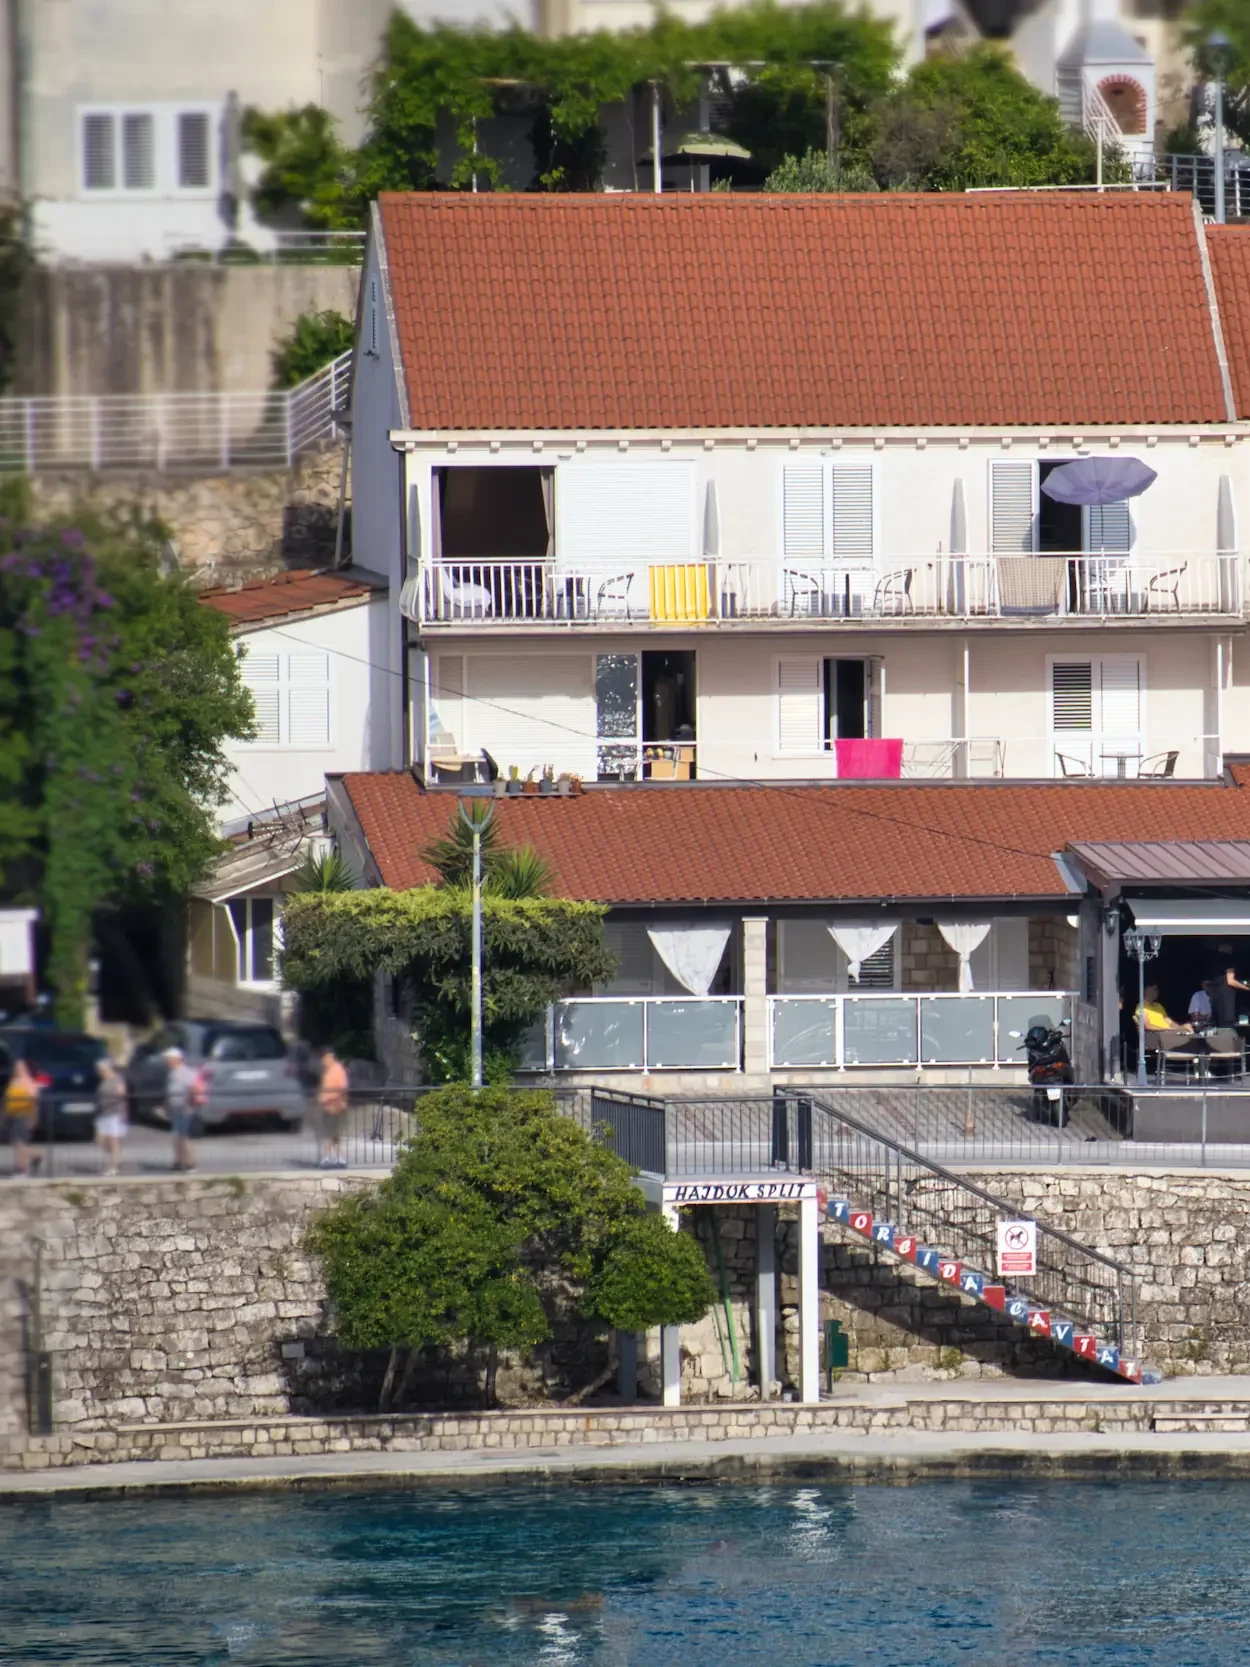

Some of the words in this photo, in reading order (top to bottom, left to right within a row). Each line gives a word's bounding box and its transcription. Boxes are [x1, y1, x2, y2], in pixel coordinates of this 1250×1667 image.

[757, 1183, 806, 1198] SPLIT
[834, 1202, 979, 1291] TORCIDA
[1009, 1302, 1138, 1378] CAVTAT
